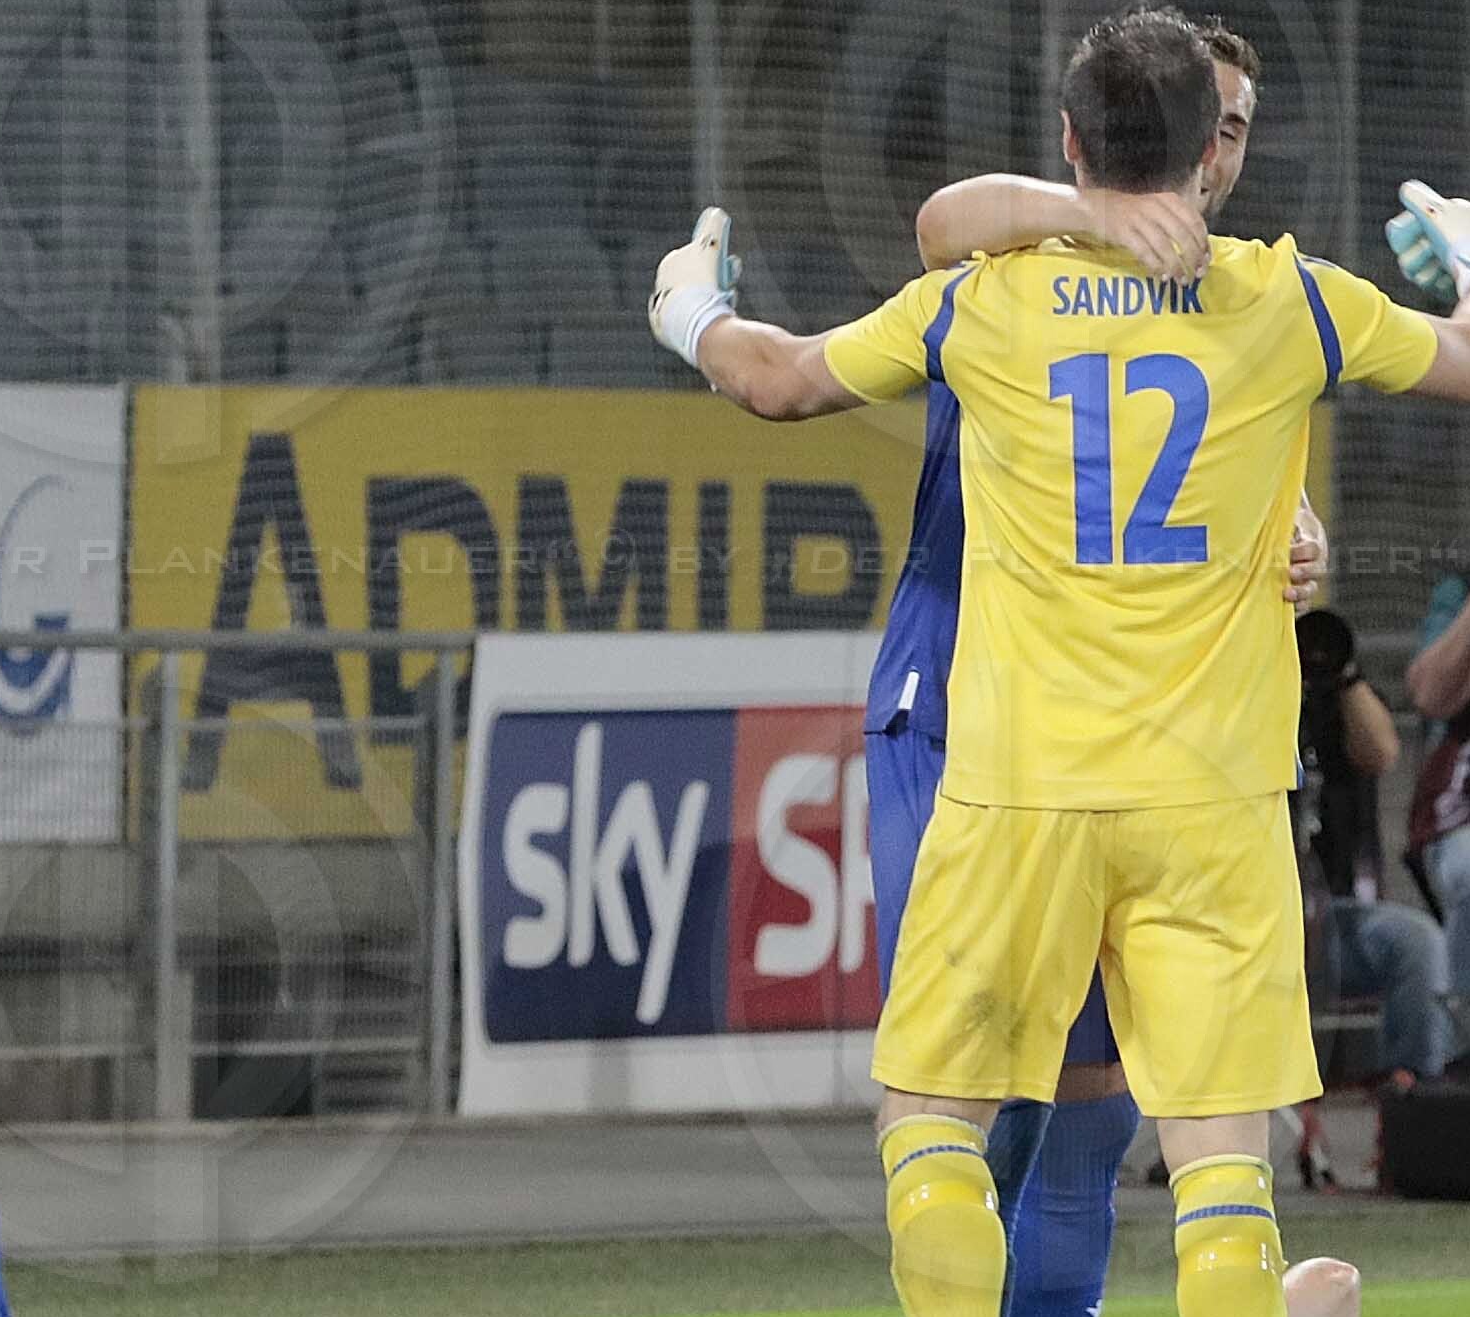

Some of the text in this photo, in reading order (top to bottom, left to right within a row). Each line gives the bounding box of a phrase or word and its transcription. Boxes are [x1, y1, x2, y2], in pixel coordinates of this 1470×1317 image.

[1052, 275, 1204, 317] SANDVIK
[1048, 352, 1211, 565] 12
[502, 720, 711, 1025] sky
